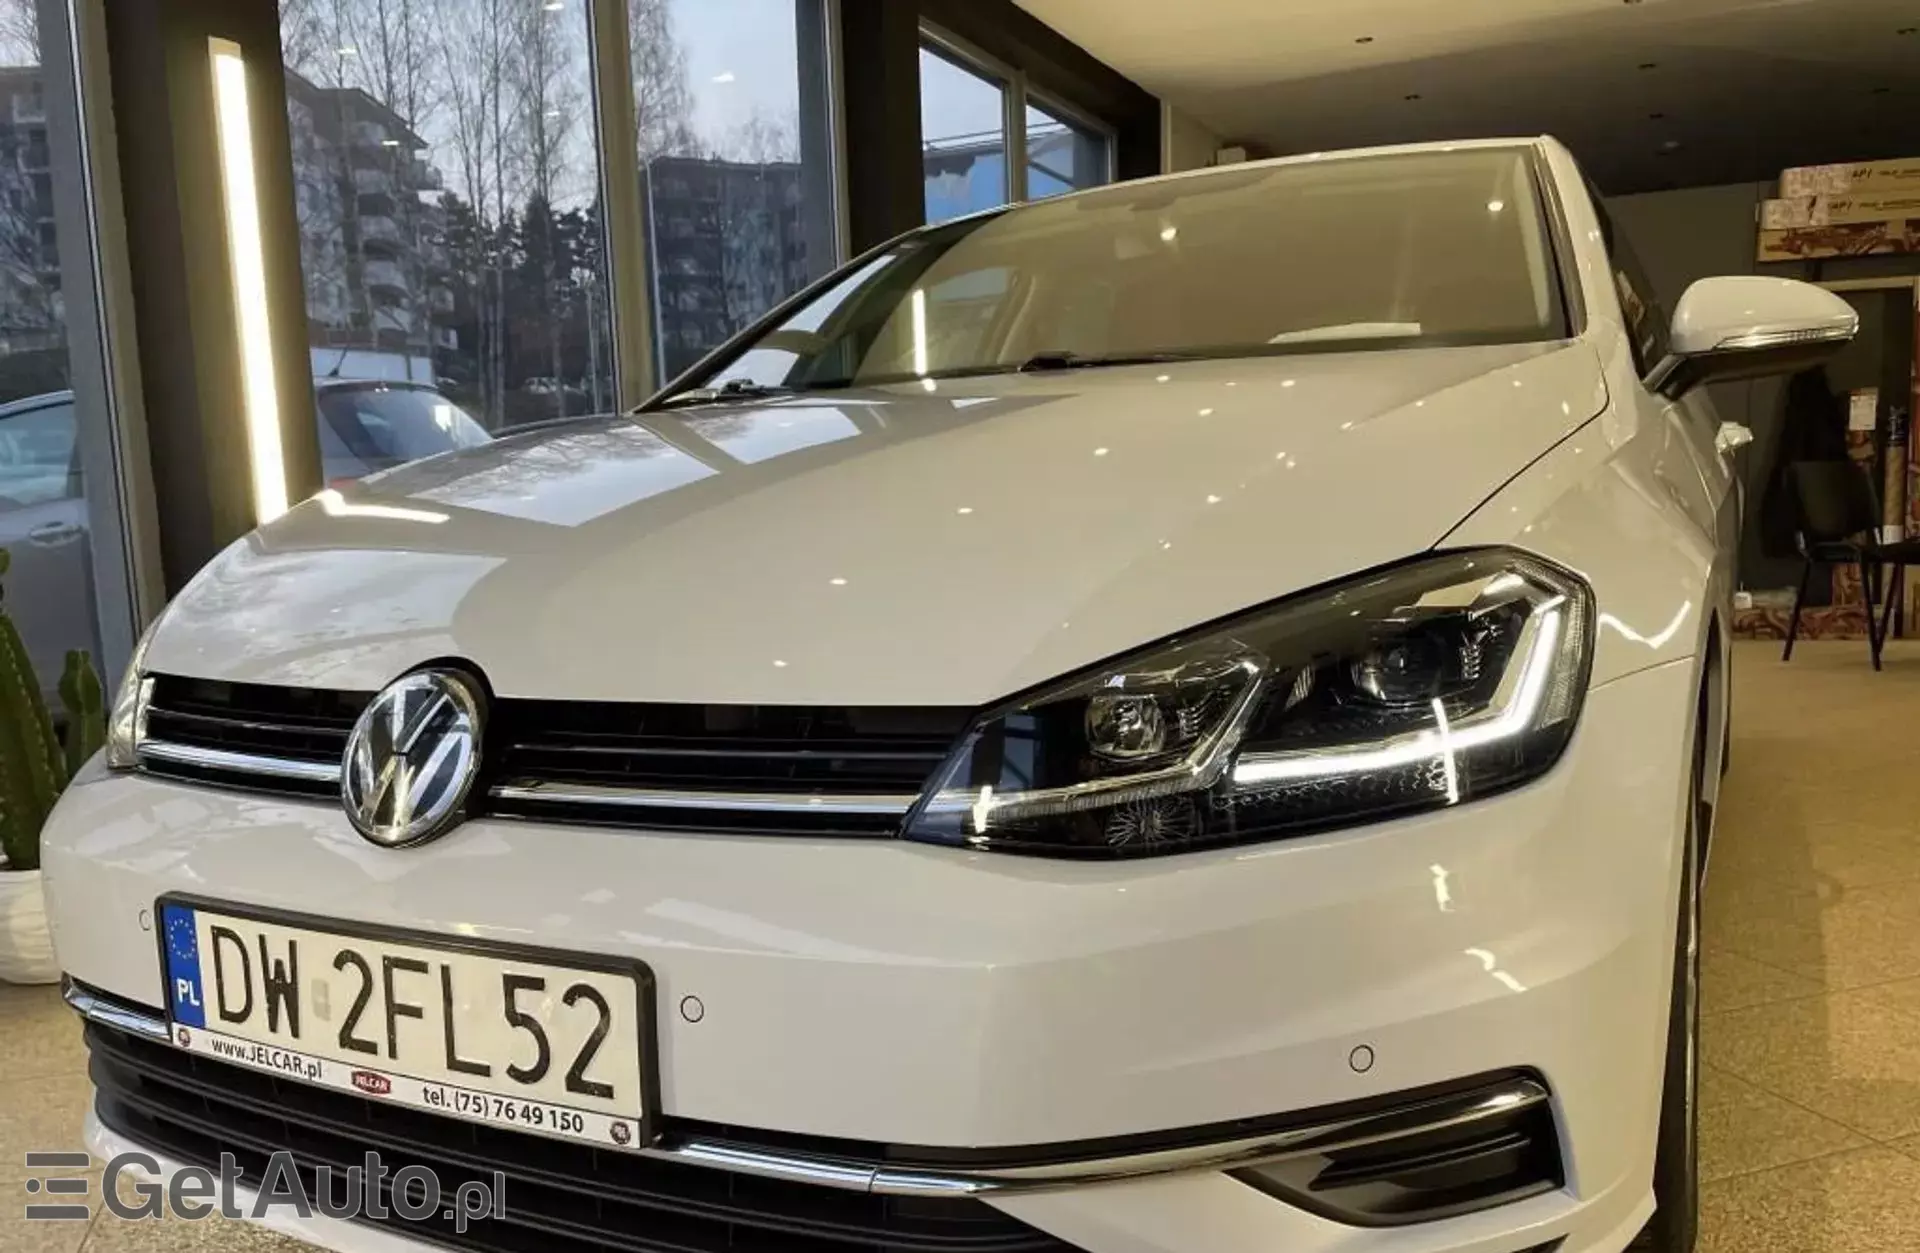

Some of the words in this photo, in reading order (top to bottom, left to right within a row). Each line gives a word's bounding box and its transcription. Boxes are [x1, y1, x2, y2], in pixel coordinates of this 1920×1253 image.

[176, 978, 200, 1007] PL
[209, 924, 301, 1039] DW
[332, 948, 615, 1100] 2FL52
[211, 1038, 323, 1081] www.JELCAR.pl
[422, 1086, 450, 1108] tel.
[455, 1091, 489, 1117] (75)
[493, 1099, 516, 1120] 76
[520, 1105, 543, 1125] 49
[549, 1109, 584, 1133] 150
